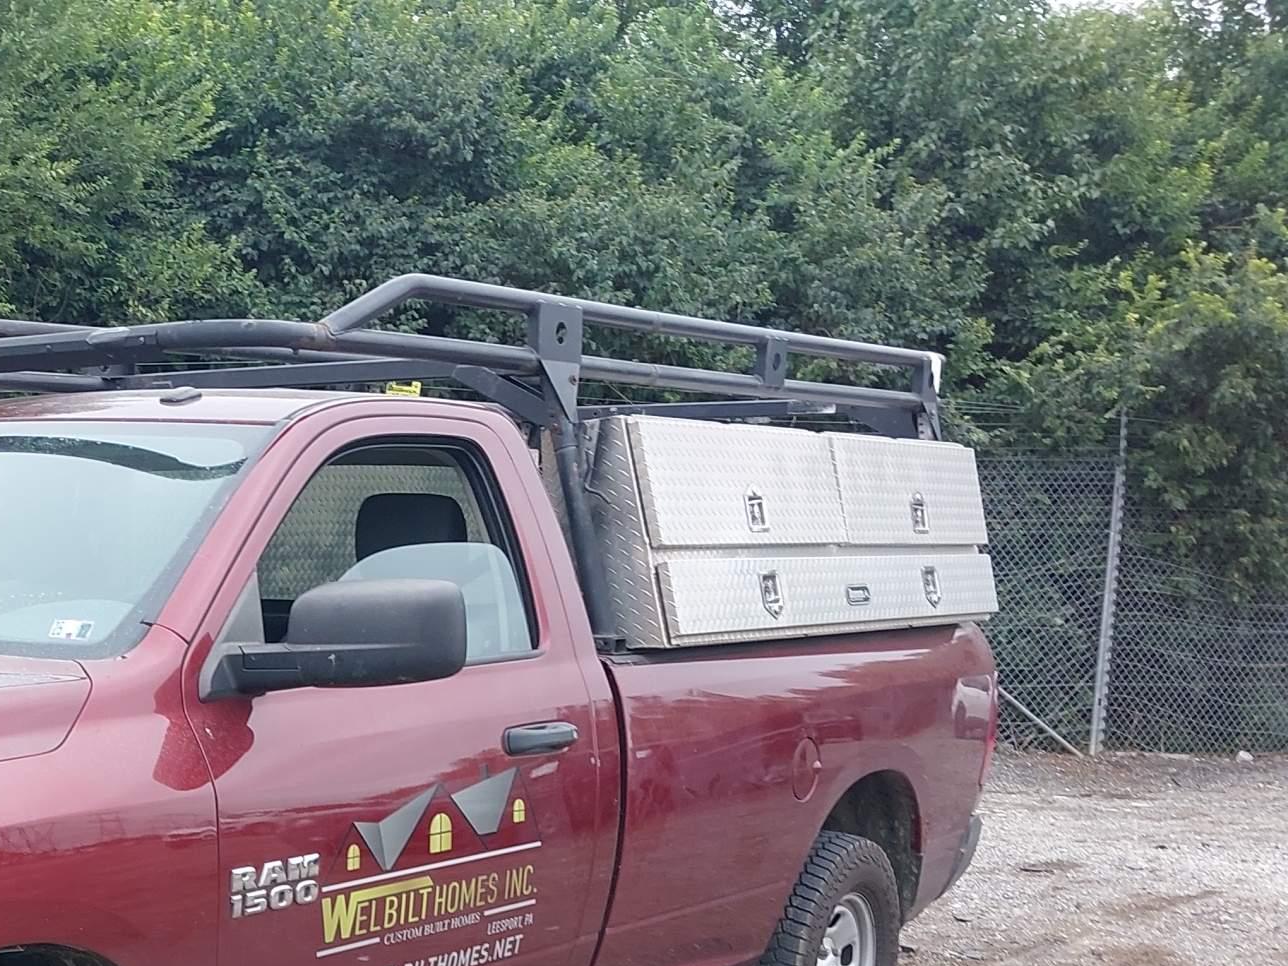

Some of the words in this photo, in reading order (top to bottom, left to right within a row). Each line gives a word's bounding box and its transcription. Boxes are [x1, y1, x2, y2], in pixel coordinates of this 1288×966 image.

[231, 853, 320, 892] RAM
[504, 865, 537, 900] INC.
[230, 879, 319, 918] 1500
[384, 927, 423, 945] CUSTOM
[424, 919, 450, 936] BUILT
[450, 912, 482, 928] HOMES
[524, 912, 534, 926] PA
